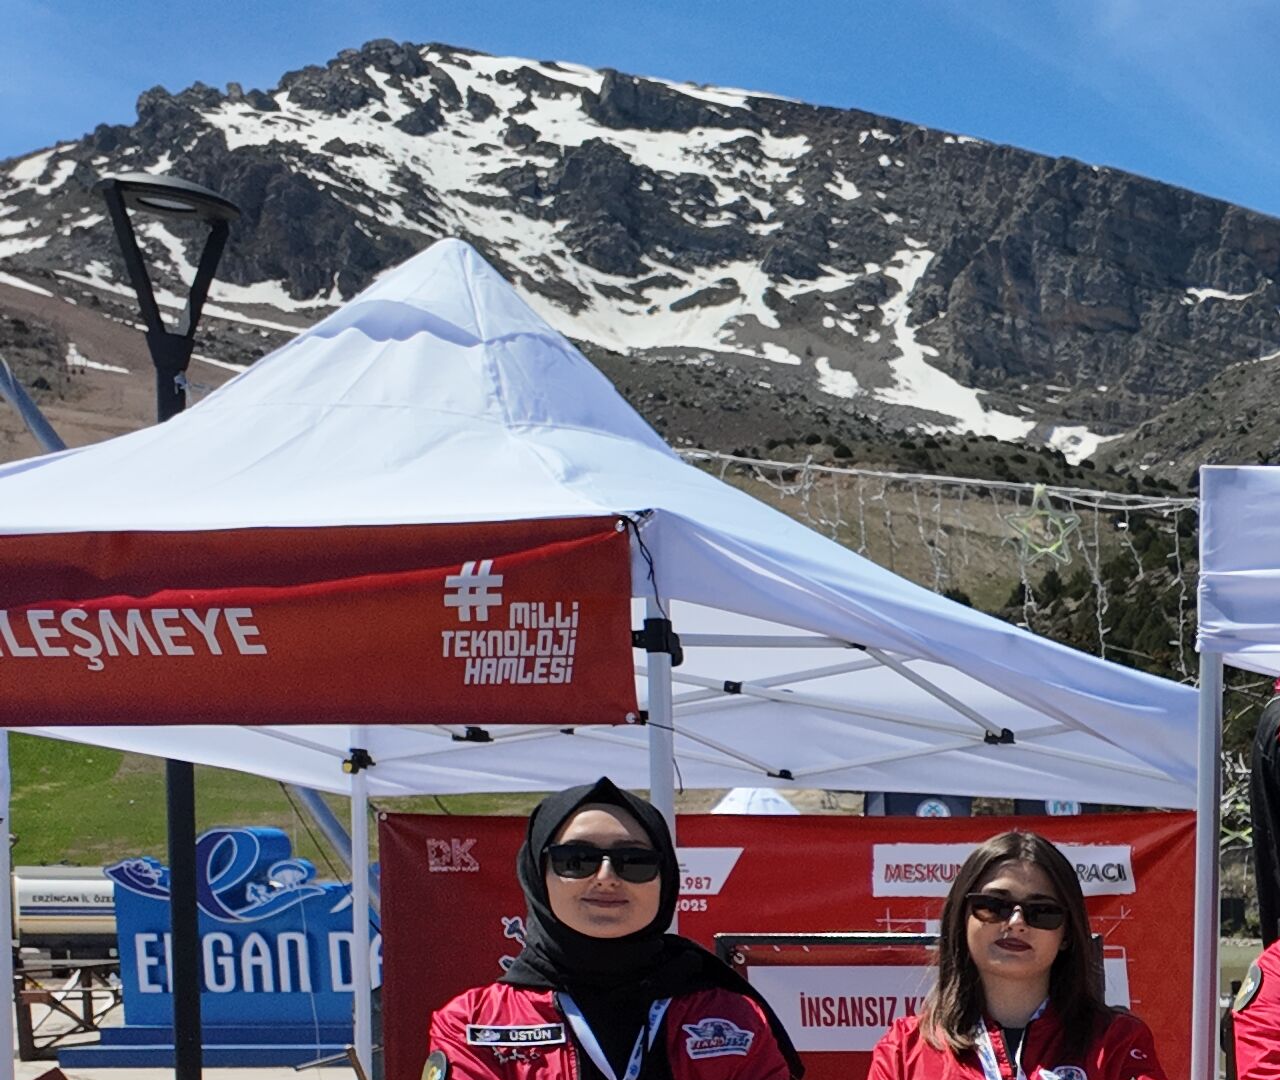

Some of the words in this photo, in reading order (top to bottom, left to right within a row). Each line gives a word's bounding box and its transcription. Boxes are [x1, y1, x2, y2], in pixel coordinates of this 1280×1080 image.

[0, 607, 268, 671] LEŞMEYE
[441, 629, 577, 658] TEKNOLOJİ
[464, 656, 574, 685] HAMLESİ
[799, 991, 898, 1028] İNSANSIZ
